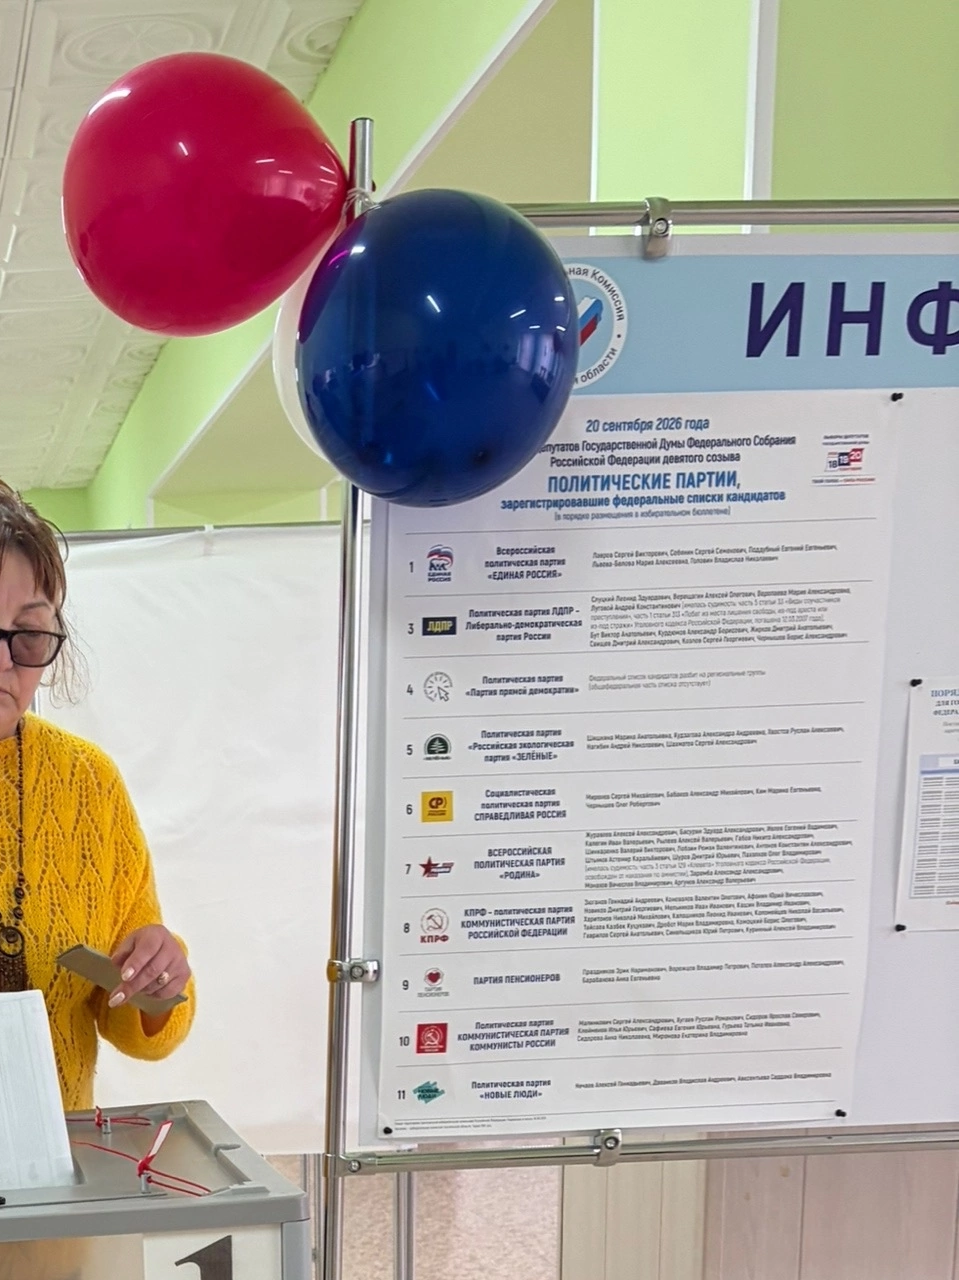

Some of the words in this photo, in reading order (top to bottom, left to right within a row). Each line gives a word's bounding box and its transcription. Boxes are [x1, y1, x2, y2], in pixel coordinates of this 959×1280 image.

[591, 269, 625, 321] Комиссия
[581, 348, 617, 383] области
[586, 419, 599, 432] 20
[602, 420, 653, 431] сентября
[655, 417, 682, 430] 2026
[684, 419, 709, 429] года
[581, 440, 657, 451] Государственной
[659, 439, 685, 449] Думы
[686, 437, 751, 447] Федерального
[753, 436, 796, 445] Собрания
[550, 455, 605, 467] Российской
[607, 455, 660, 465] Федерации
[662, 454, 703, 463] девятого
[705, 453, 740, 461] созыва
[548, 473, 671, 492] ПОЛИТИЧЕСКИЕ
[674, 470, 741, 488] ПАРТИИ,
[501, 497, 610, 509] зарегистрировавшие
[612, 495, 684, 506] федеральные
[686, 493, 723, 503] списки
[725, 491, 785, 502] кандидатов
[485, 559, 538, 567] политическая
[488, 570, 524, 579] «ЕДИНАЯ
[525, 569, 561, 578] РОССИЯ»
[469, 609, 522, 617] Политическая
[551, 606, 574, 615] ЛДПР
[427, 621, 453, 631] ЛДПР
[481, 730, 534, 738] Политическая
[512, 751, 557, 760] «ЗЕЛЁНЫЕ»
[475, 811, 534, 820] СПРАВЕДЛИВАЯ
[536, 810, 566, 818] РОССИЯ
[488, 847, 552, 856] ВСЕРОССИЙСКАЯ
[474, 859, 533, 868] ПОЛИТИЧЕСКАЯ
[535, 858, 565, 866] ПАРТИЯ
[499, 870, 540, 879] «РОДИНА»
[464, 908, 486, 916] КПРФ
[493, 907, 545, 915] политическая
[461, 917, 544, 927] КОММУНИСТИЧЕСКАЯ
[545, 916, 575, 924] ПАРТИЯ
[468, 929, 519, 938] РОССИЙСКОЙ
[521, 928, 567, 936] ФЕДЕРАЦИИ
[420, 935, 449, 944] КПРФ
[474, 976, 503, 984] ПАРТИЯ
[504, 973, 560, 983] ПЕНСИОНЕРОВ
[476, 1021, 527, 1029] Политическая
[458, 1030, 538, 1040] КОММУНИСТИЧЕСКАЯ
[540, 1027, 569, 1035] ПАРТИЯ
[399, 1036, 410, 1047] 10
[470, 1041, 523, 1050] КОММУНИСТЫ
[525, 1039, 555, 1047] РОССИИ
